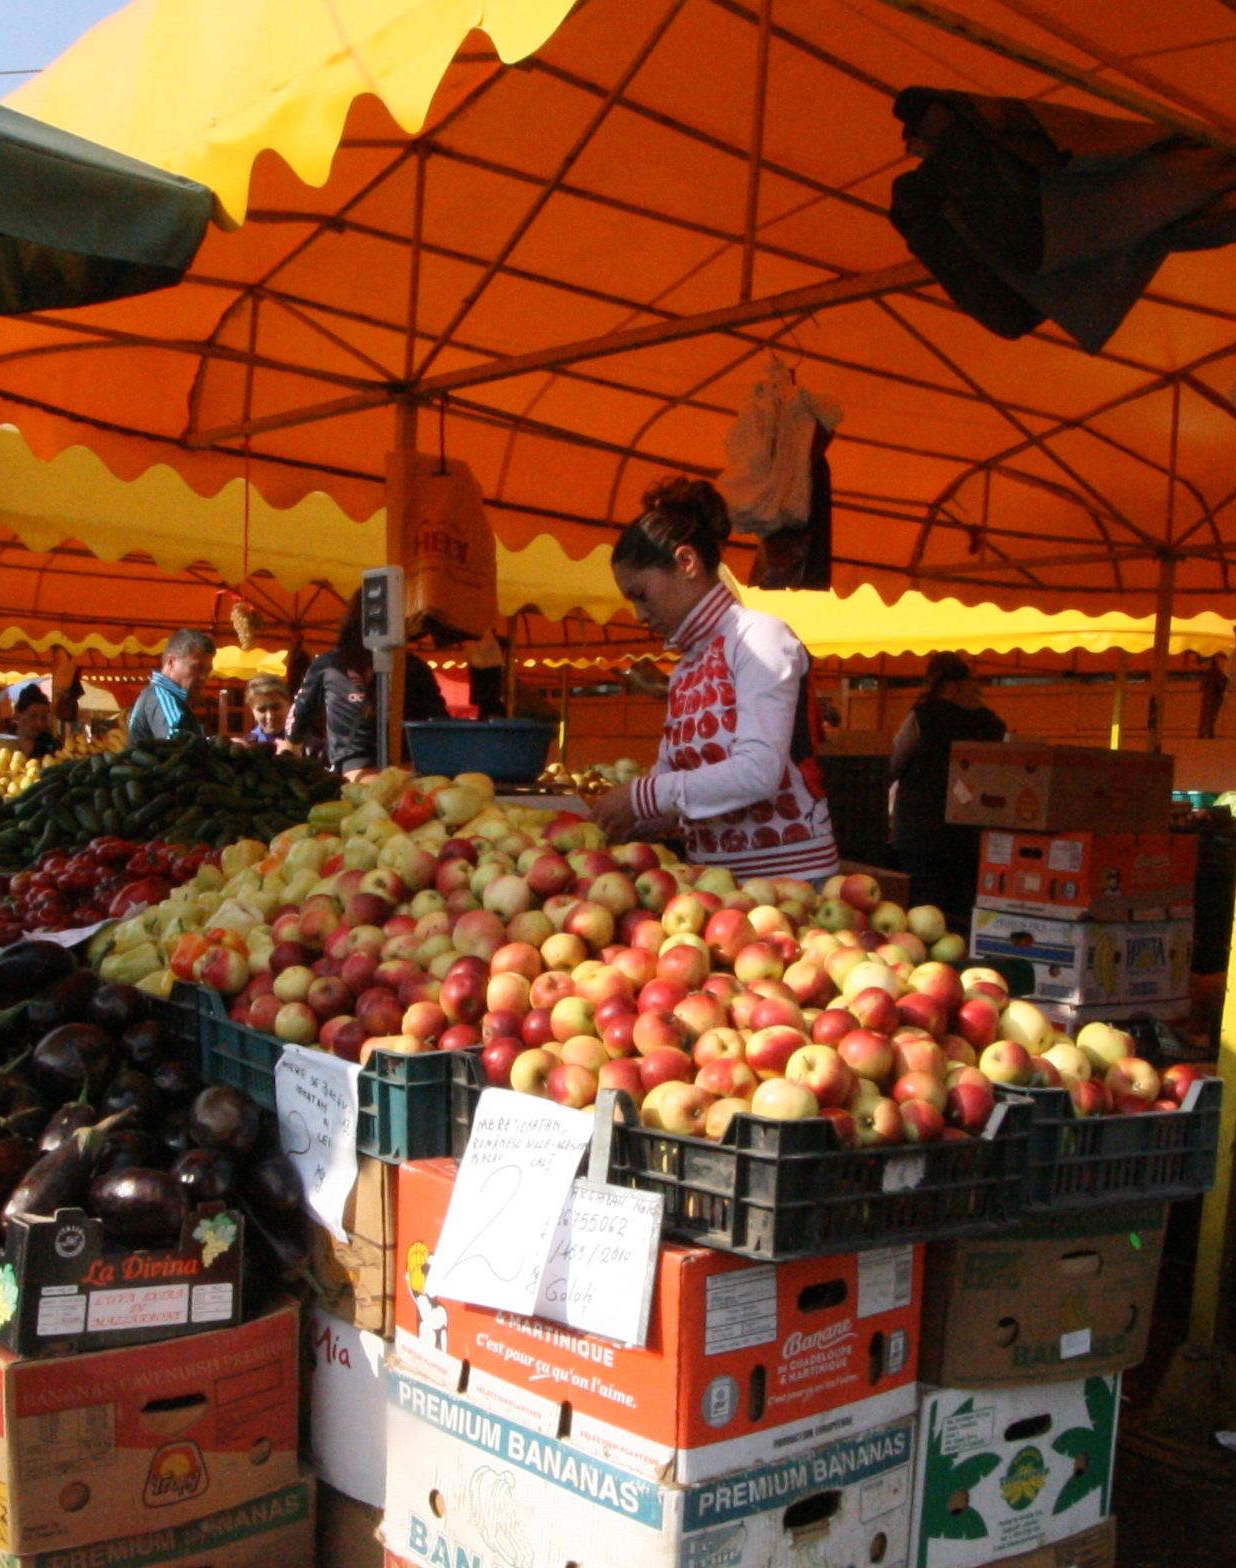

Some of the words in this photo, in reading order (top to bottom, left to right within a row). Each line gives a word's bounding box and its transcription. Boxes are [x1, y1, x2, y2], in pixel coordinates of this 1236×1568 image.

[82, 1259, 115, 1286] La
[122, 1253, 199, 1281] Divina
[476, 1332, 504, 1356] C'est
[504, 1346, 536, 1368] pour
[551, 1365, 590, 1391] qu'on
[590, 1376, 637, 1409] l'aime.
[508, 1312, 615, 1368] MARTINIQUE
[782, 1319, 858, 1359] Banane
[398, 1381, 502, 1452] PREMIUM
[507, 1429, 640, 1515] BANANAS
[698, 1467, 808, 1517] PREMIUM
[814, 1432, 907, 1482] BANANAS
